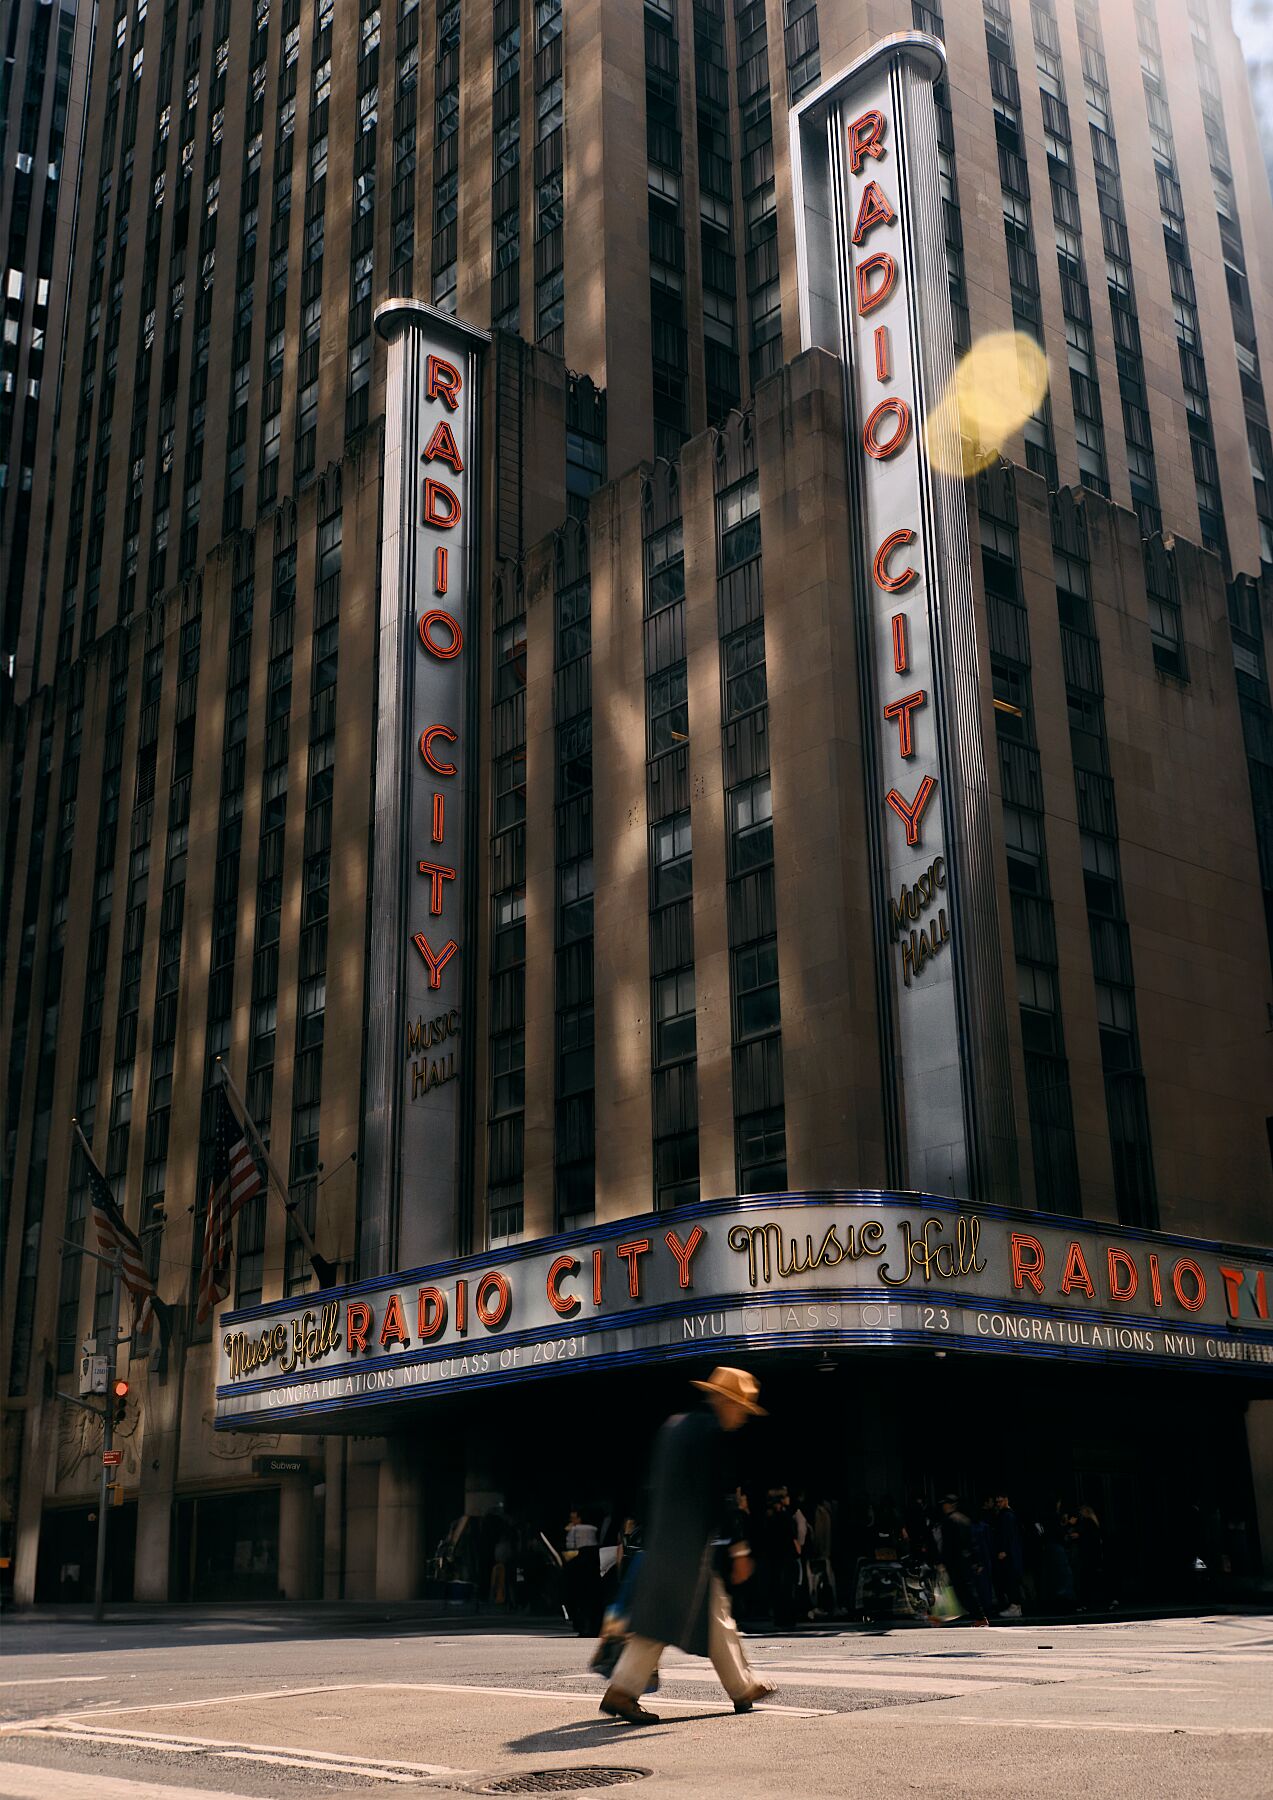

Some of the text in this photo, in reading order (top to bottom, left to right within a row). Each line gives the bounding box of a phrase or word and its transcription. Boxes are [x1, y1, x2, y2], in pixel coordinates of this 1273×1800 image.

[847, 109, 938, 846] RADIO CITY
[411, 354, 463, 990] RADIO CITY
[728, 1215, 987, 1287] Music Hall
[1010, 1231, 1207, 1312] RADIO
[346, 1225, 707, 1355] RADIO CITY
[683, 1313, 724, 1339] NYU
[744, 1305, 840, 1331] CLASS
[862, 1305, 898, 1328] OF
[223, 1299, 341, 1381] Music Hall
[268, 1335, 586, 1407] CONGRATULATIONS NYU CLASS OF 2023!
[976, 1313, 1155, 1352] CONGRATULATIONS
[1164, 1334, 1196, 1357] NYU
[270, 1461, 301, 1472] Subway
